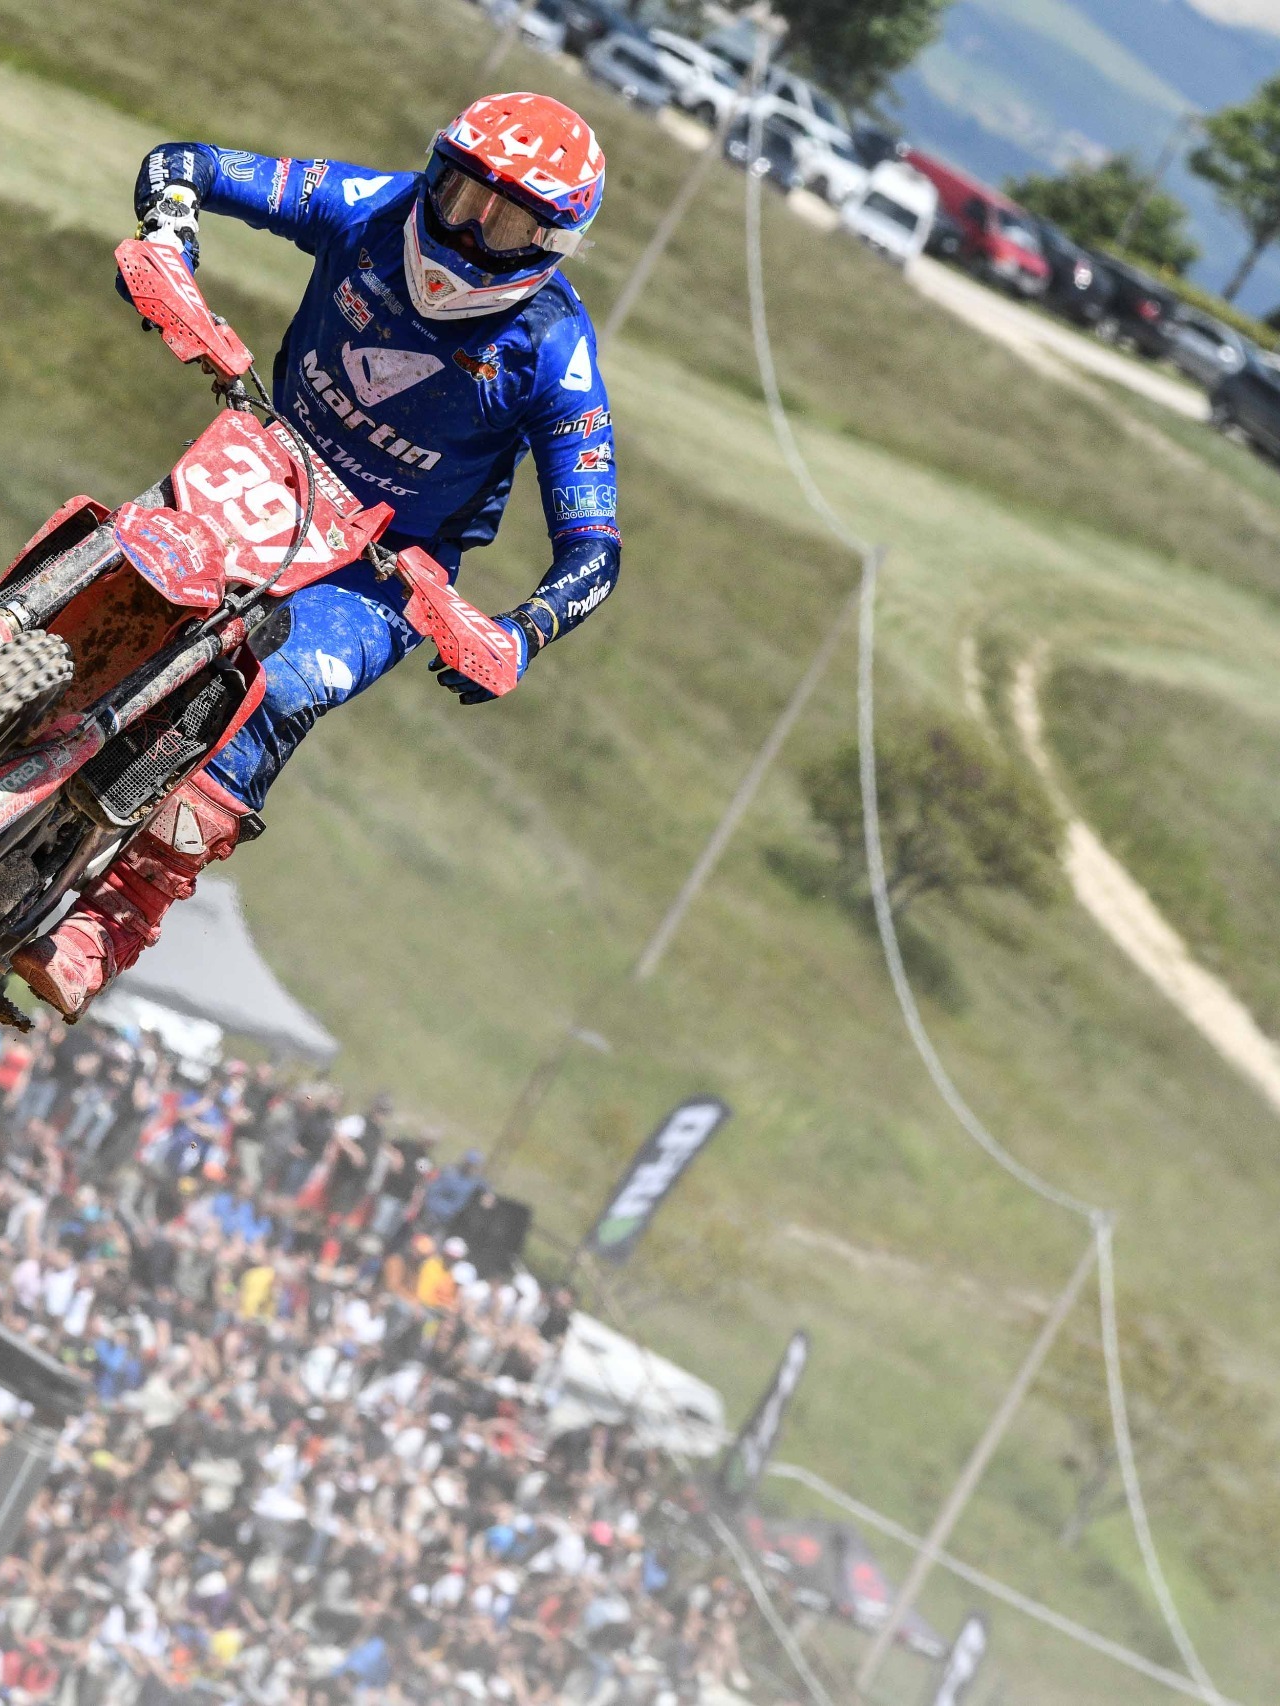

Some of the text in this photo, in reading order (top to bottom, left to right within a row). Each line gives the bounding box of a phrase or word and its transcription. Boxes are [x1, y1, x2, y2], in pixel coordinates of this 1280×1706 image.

[152, 246, 205, 308] UFO
[411, 320, 439, 342] SKYLINE
[303, 349, 442, 471] Martin
[185, 444, 335, 564] 397
[273, 428, 345, 510] RENHAL
[457, 600, 514, 650] UFO
